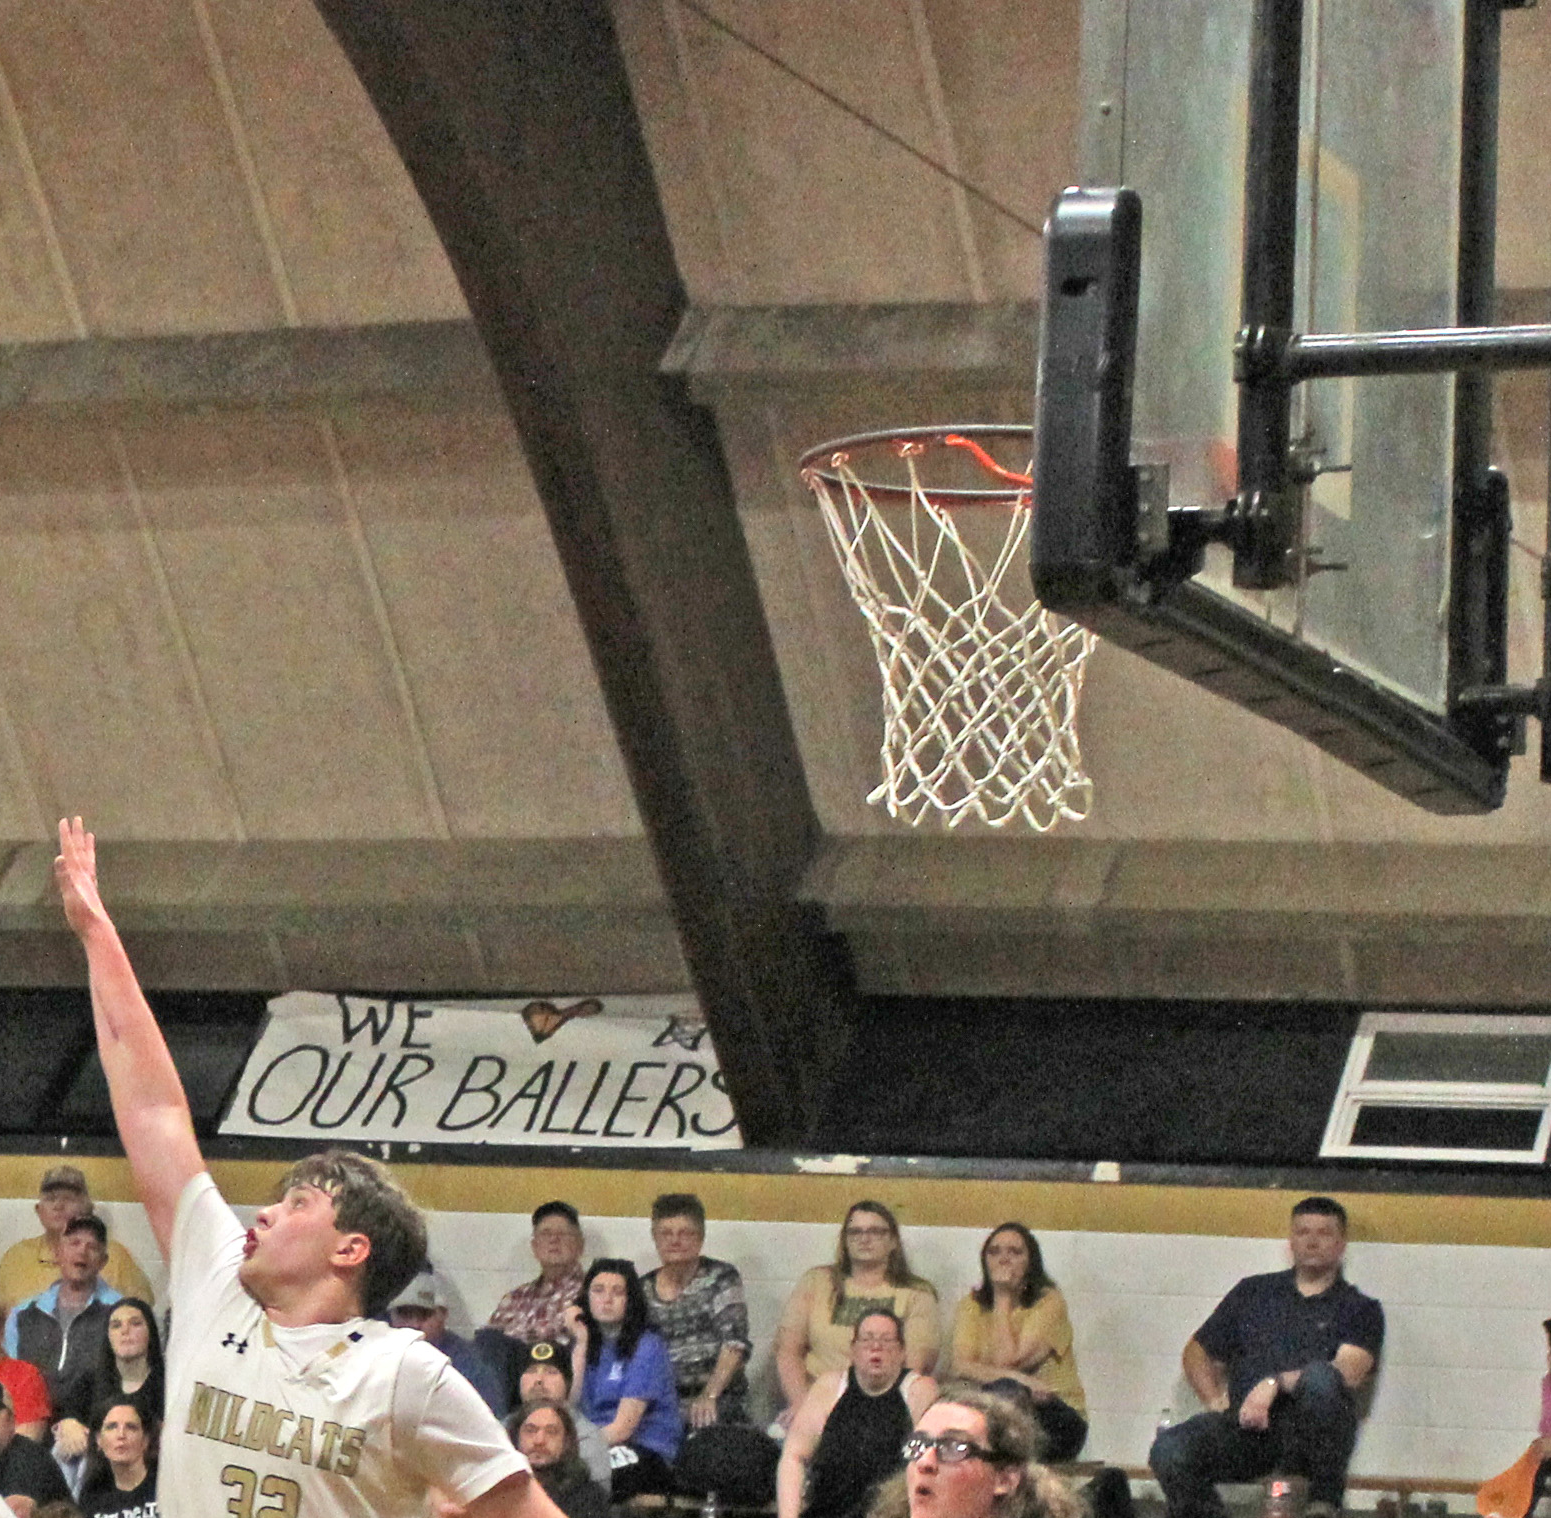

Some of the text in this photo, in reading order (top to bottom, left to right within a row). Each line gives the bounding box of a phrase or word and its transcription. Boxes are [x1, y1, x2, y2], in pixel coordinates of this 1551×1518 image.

[335, 993, 434, 1049] WE
[247, 1043, 739, 1139] OUR BALLERS
[184, 1380, 367, 1479] WILDCATS
